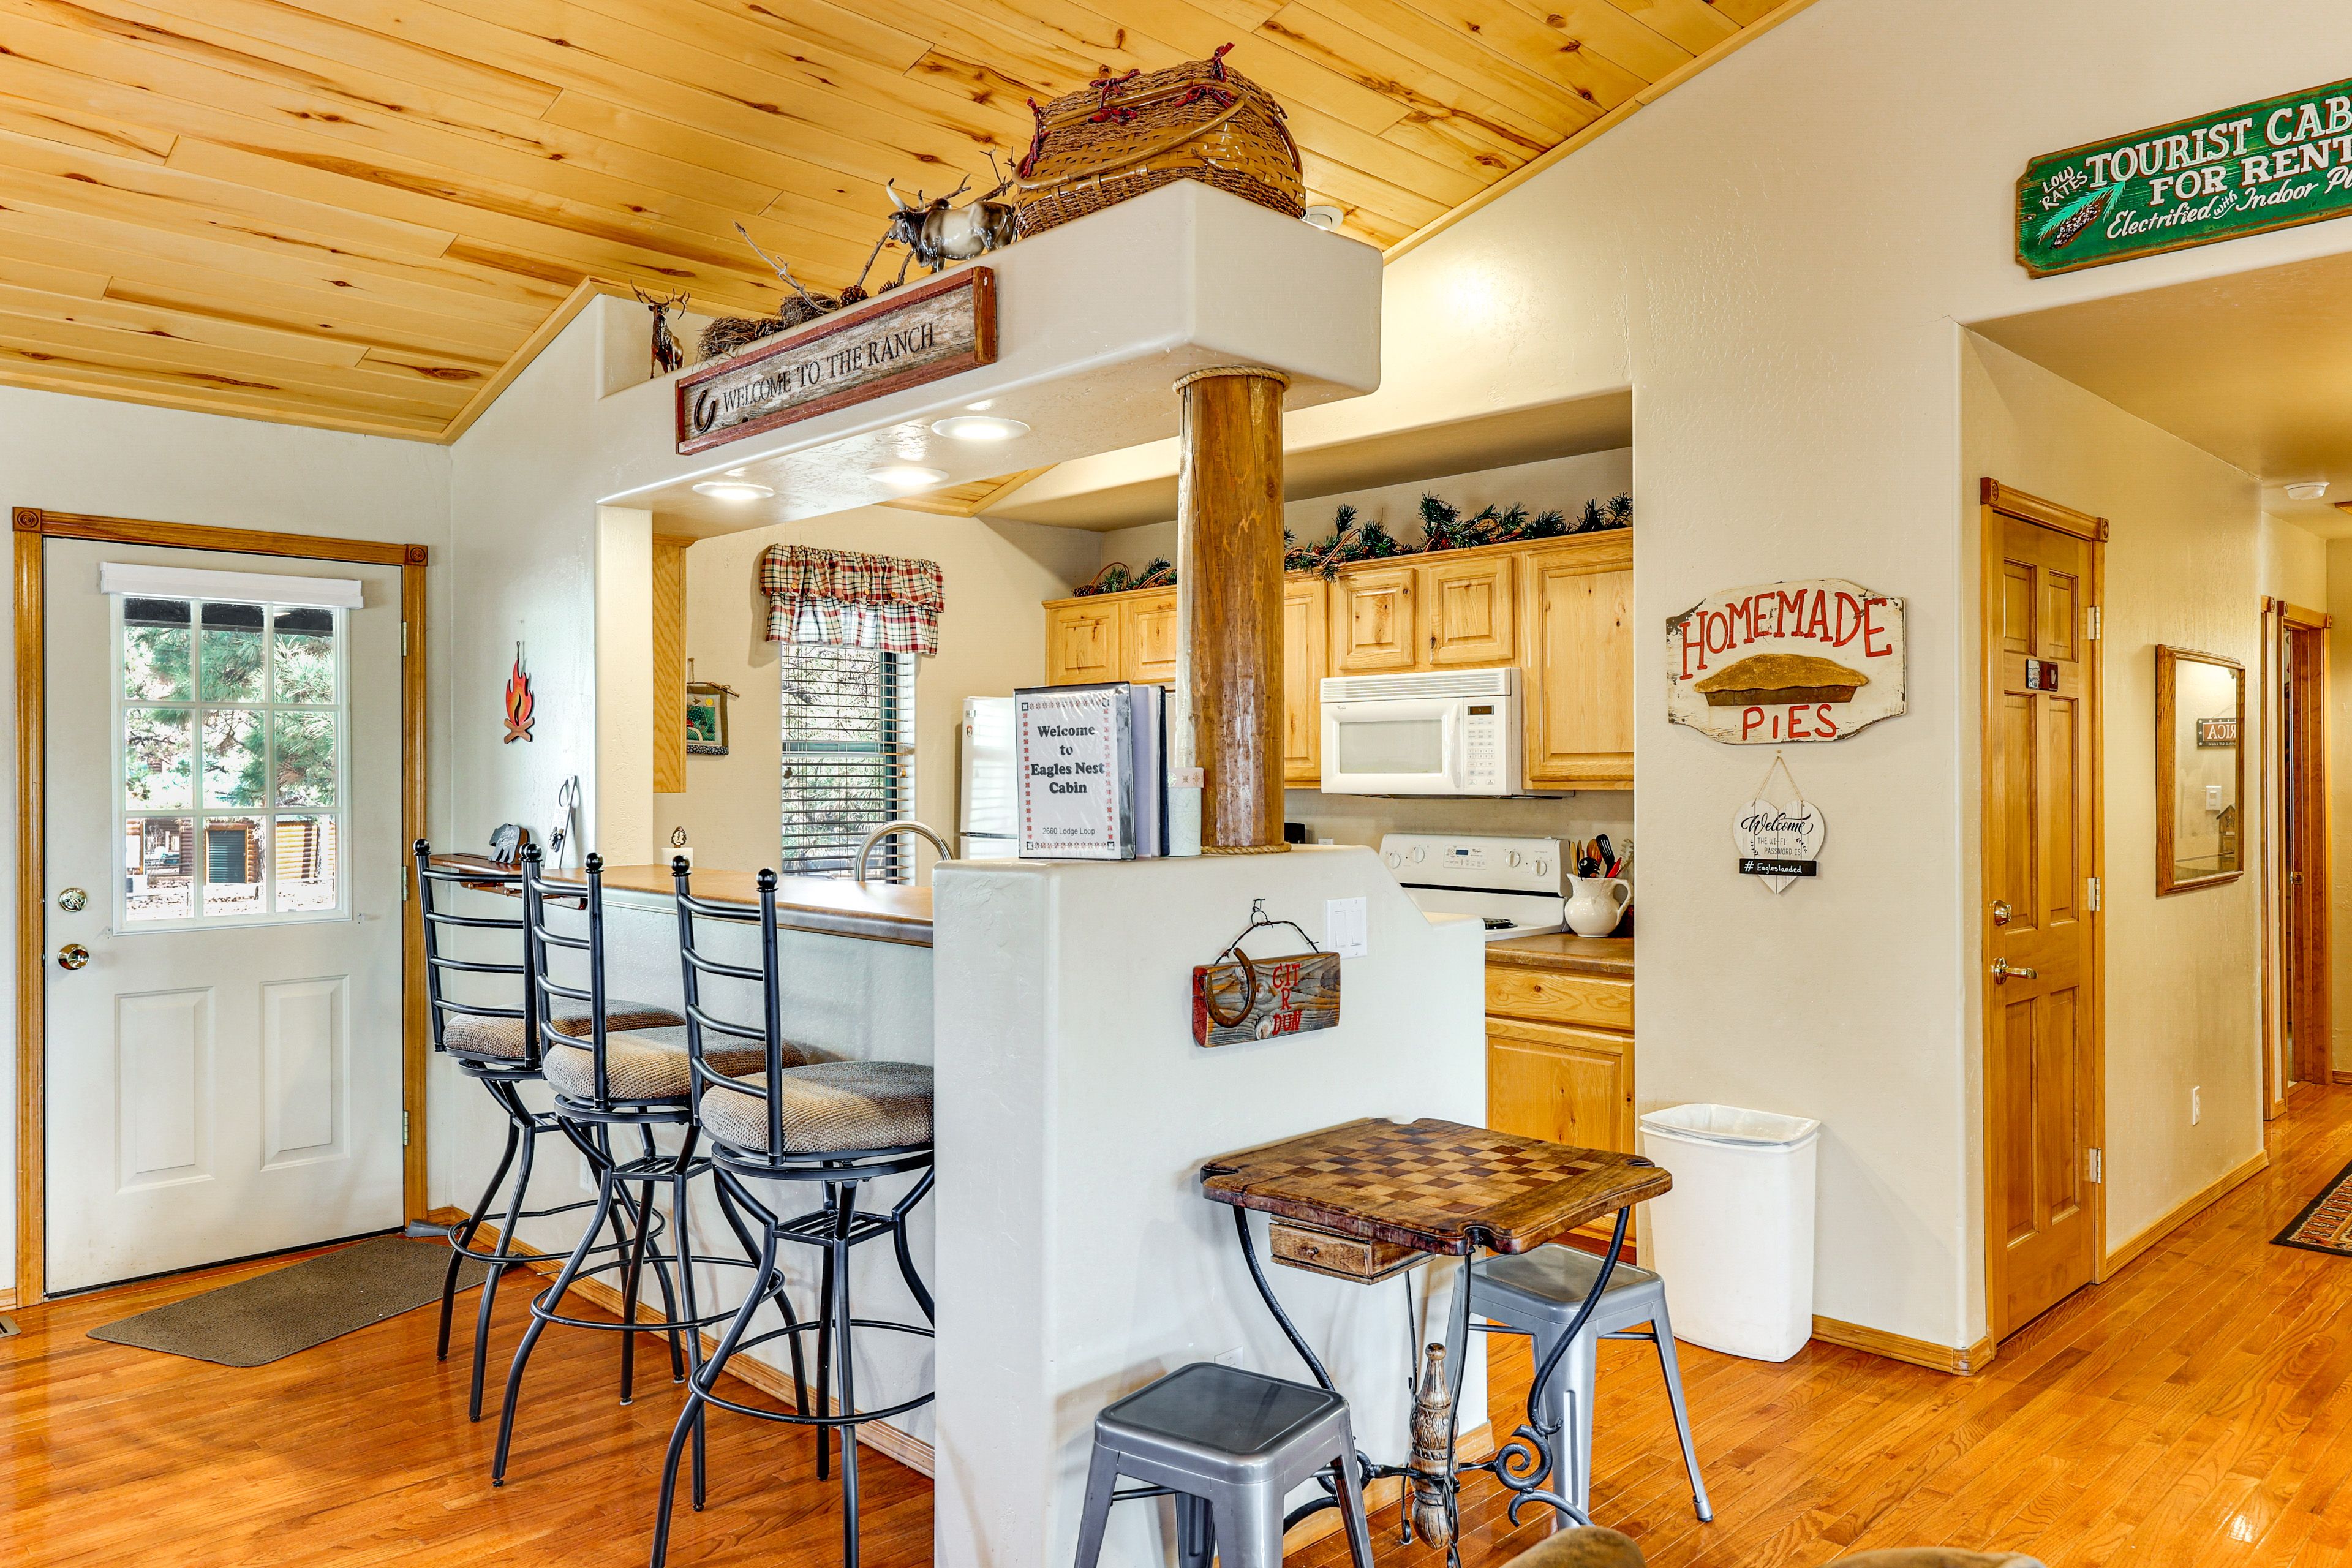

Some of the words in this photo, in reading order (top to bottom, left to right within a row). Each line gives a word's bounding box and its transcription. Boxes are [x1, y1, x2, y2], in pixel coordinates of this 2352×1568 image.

[2085, 118, 2252, 188] TOURIST
[2266, 96, 2352, 146] CAB
[2042, 165, 2075, 194] LOW
[2149, 165, 2228, 206] FOR
[2242, 134, 2352, 186] RENT
[2038, 171, 2088, 211] RATES
[2106, 195, 2220, 239] Electrified
[2212, 189, 2239, 217] with
[2235, 178, 2320, 212] Indoor
[723, 371, 791, 412] WELCOME
[797, 360, 821, 388] TO
[827, 346, 862, 378] THE
[867, 323, 935, 366] RANCH
[1679, 588, 1893, 680] HOMEMADE
[1037, 725, 1095, 737] Welcome
[1741, 703, 1839, 741] PIES
[1059, 745, 1073, 755] to
[1031, 763, 1072, 778] Eagles
[1075, 762, 1105, 774] Nest
[1049, 782, 1087, 794] Cabin
[1059, 827, 1078, 836] Lodge
[1740, 812, 1814, 835] Welcome
[1764, 847, 1793, 856] PASSWORD
[1272, 963, 1301, 989] GIT
[1280, 987, 1292, 1011] R
[1272, 1009, 1302, 1036] DUN
